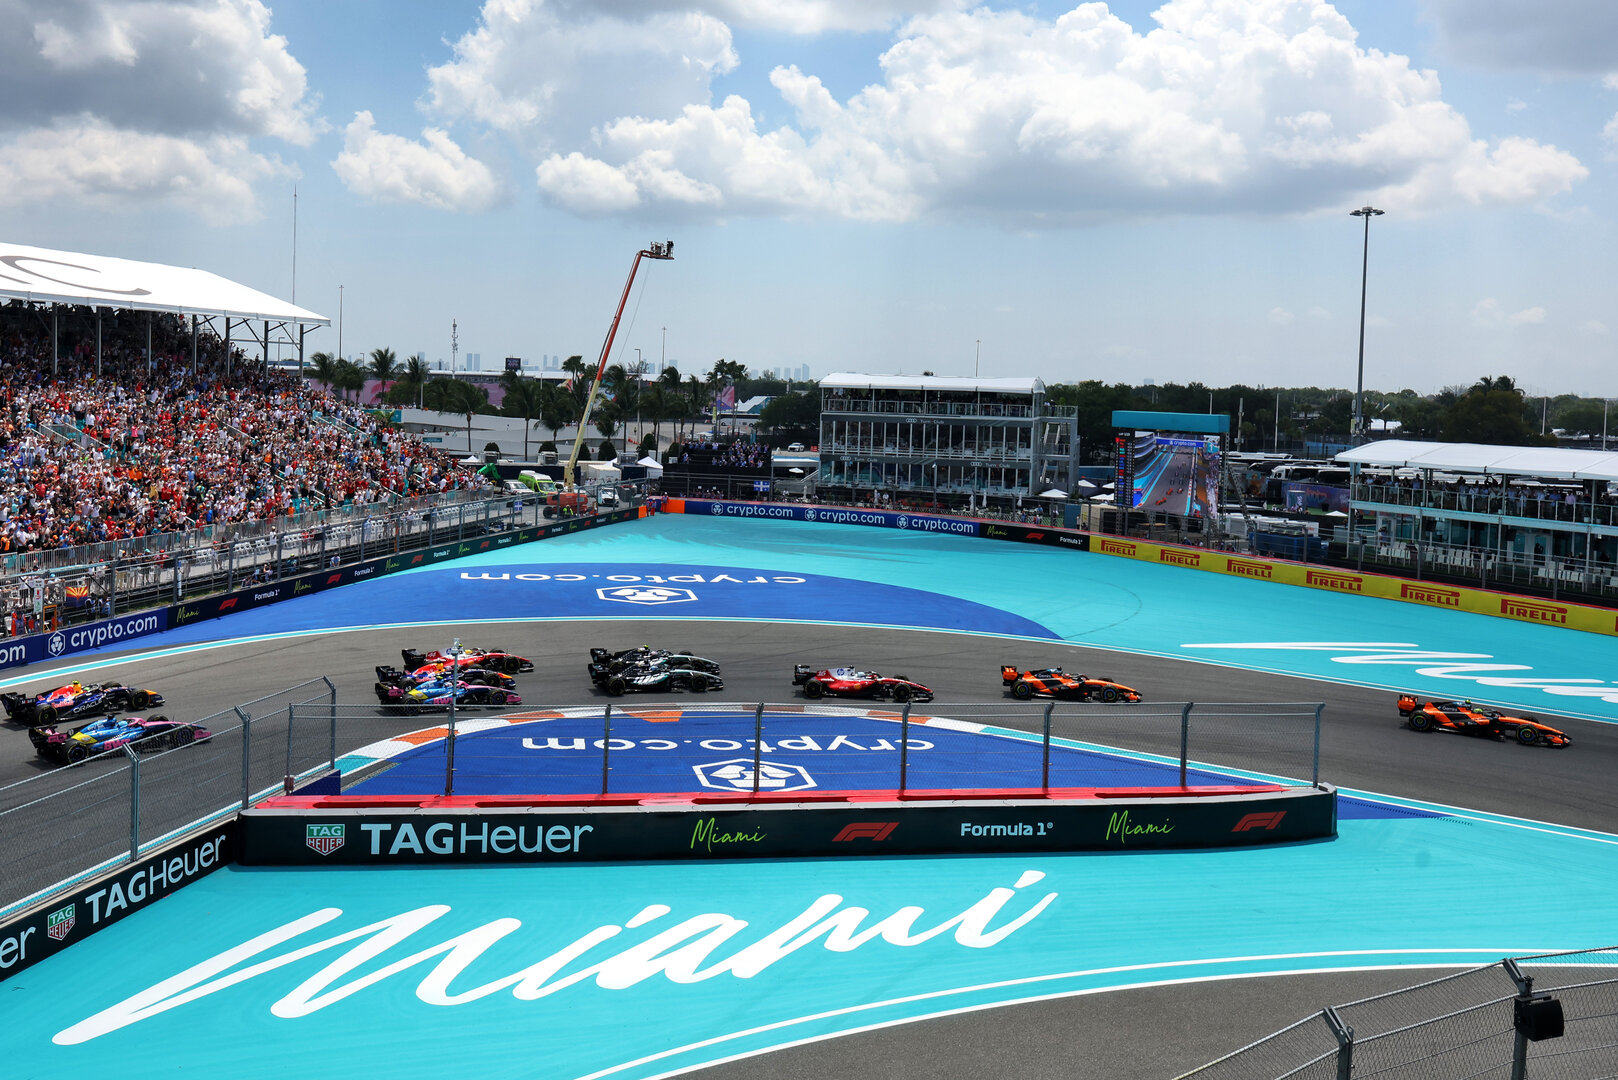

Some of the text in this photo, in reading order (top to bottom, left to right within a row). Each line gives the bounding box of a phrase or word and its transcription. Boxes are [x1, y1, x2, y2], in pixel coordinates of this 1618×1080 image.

[727, 504, 793, 518] crypto.com
[820, 511, 885, 525] crypto.com
[911, 518, 974, 533] crypto.com
[986, 525, 1007, 537] Miami
[1059, 536, 1077, 544] Formula
[1101, 539, 1136, 557] PIRELLI
[1160, 548, 1200, 567] PIRELLI
[354, 568, 370, 577] Formula
[1227, 559, 1272, 578] PIRELLI
[460, 572, 807, 584] crypto.com
[1306, 570, 1363, 591] PIRELLI
[294, 579, 312, 595] Miami
[1401, 583, 1461, 607] PIRELLI
[255, 591, 275, 601] Formula
[176, 606, 199, 623] Miami
[1500, 598, 1568, 624] PIRELLI
[71, 615, 158, 647] crypto.com
[73, 698, 103, 714] ORACLE
[522, 735, 935, 753] crypto.com
[309, 826, 341, 837] TAG
[690, 817, 767, 853] Miami
[961, 822, 1033, 837] Formula
[1106, 810, 1175, 844] Miami
[308, 837, 344, 854] HEUER
[50, 906, 74, 925] TAG
[49, 917, 75, 940] HEUER
[51, 871, 1058, 1046] Miami
